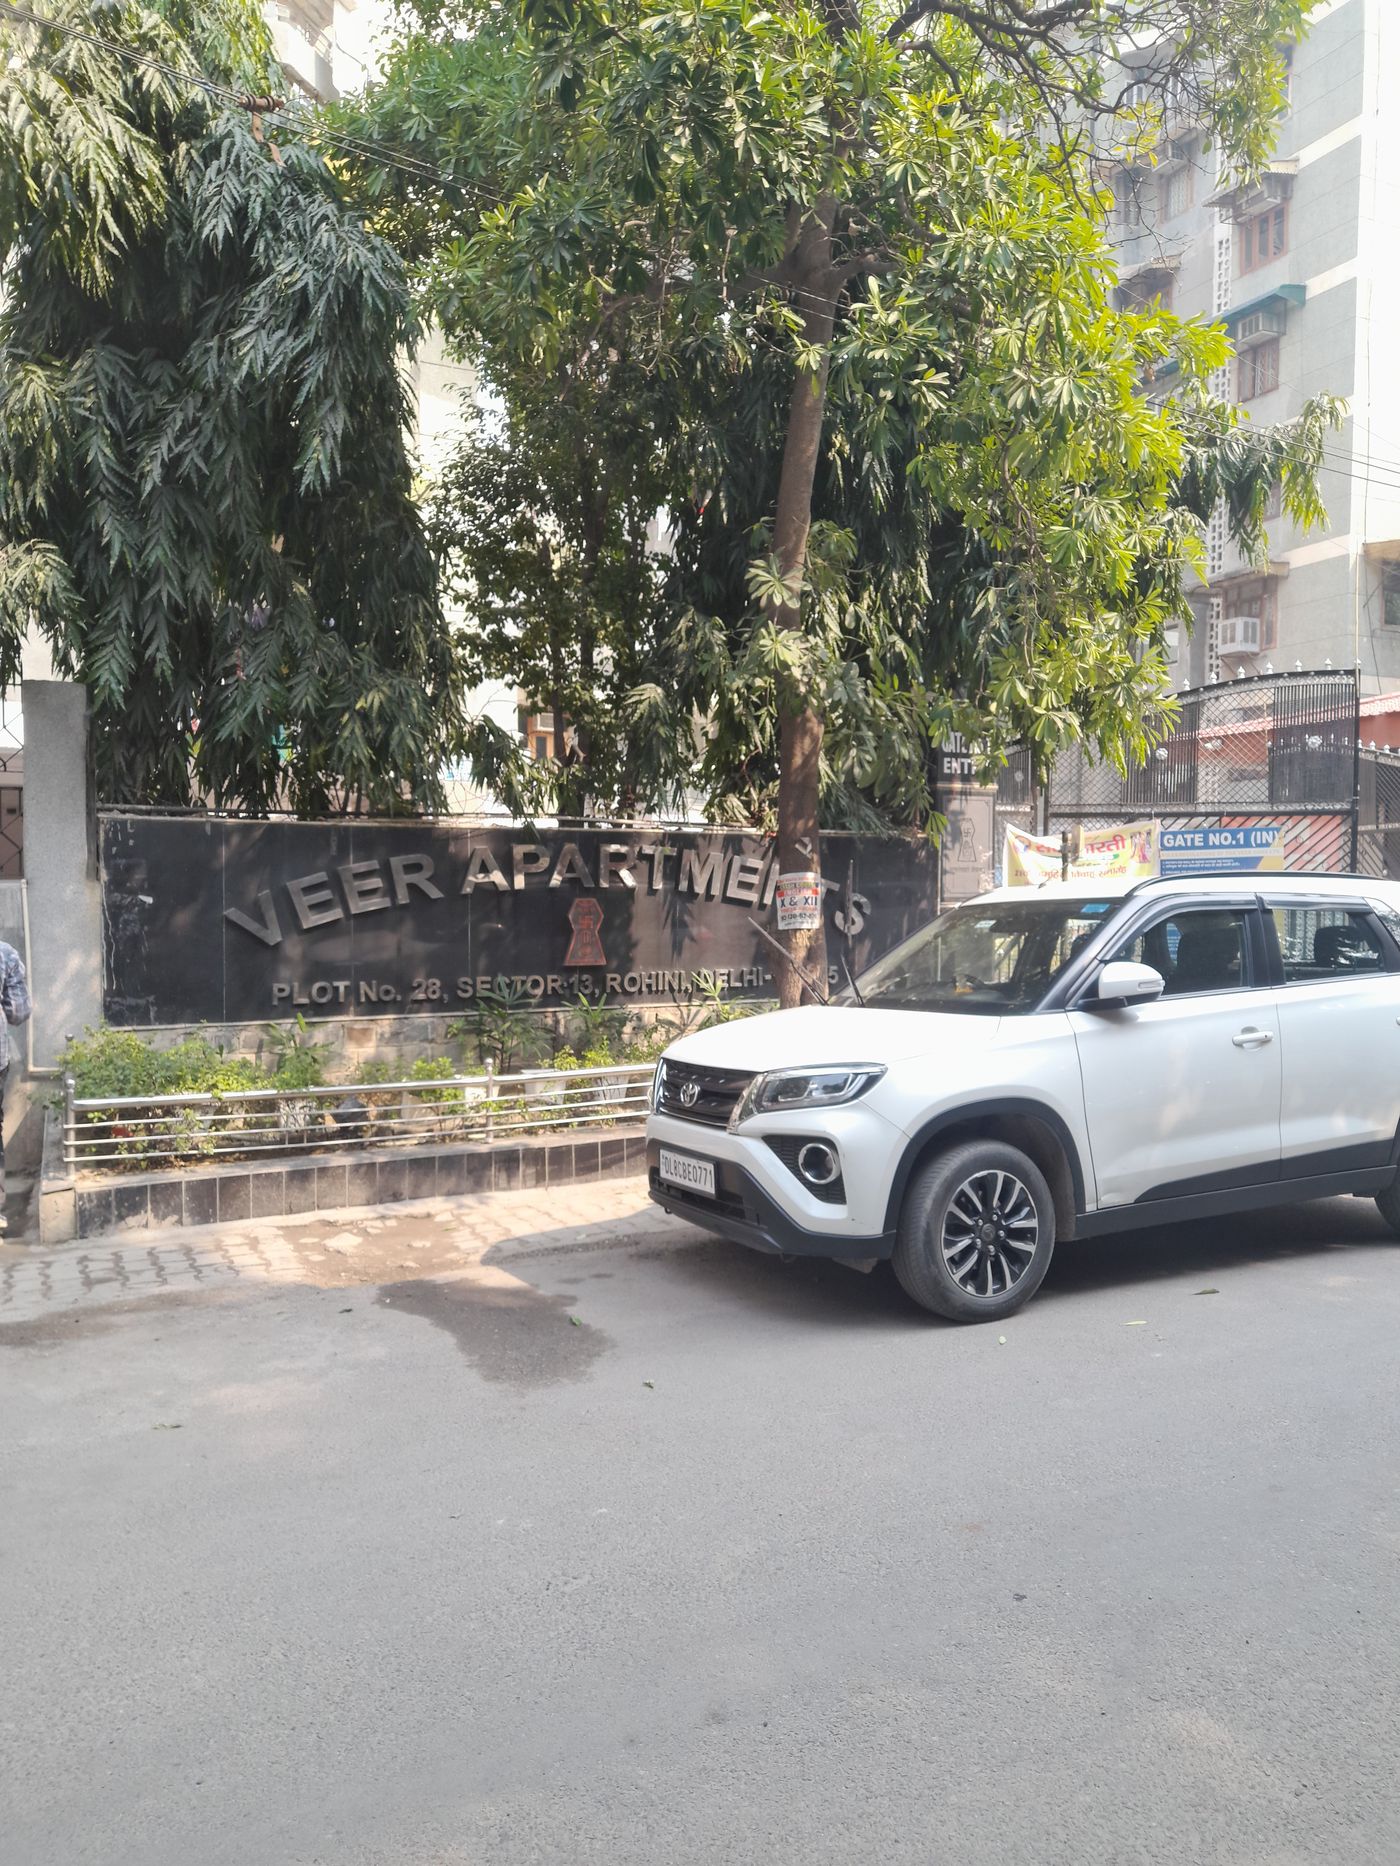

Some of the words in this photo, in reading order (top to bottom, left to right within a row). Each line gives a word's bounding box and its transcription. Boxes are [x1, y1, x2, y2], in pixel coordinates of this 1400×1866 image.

[1163, 832, 1204, 847] GATE
[1208, 831, 1245, 846] NO.1
[1250, 830, 1278, 848] (IN)
[224, 852, 444, 947] VEER
[461, 842, 872, 936] APARTMES
[789, 896, 799, 907] &
[803, 895, 818, 906] XII
[272, 980, 351, 1006] PLOT
[359, 979, 402, 1004] No.
[411, 978, 449, 1004] 28,
[606, 970, 692, 993] ROHINI,
[664, 1156, 713, 1189] DL8CBE0771
